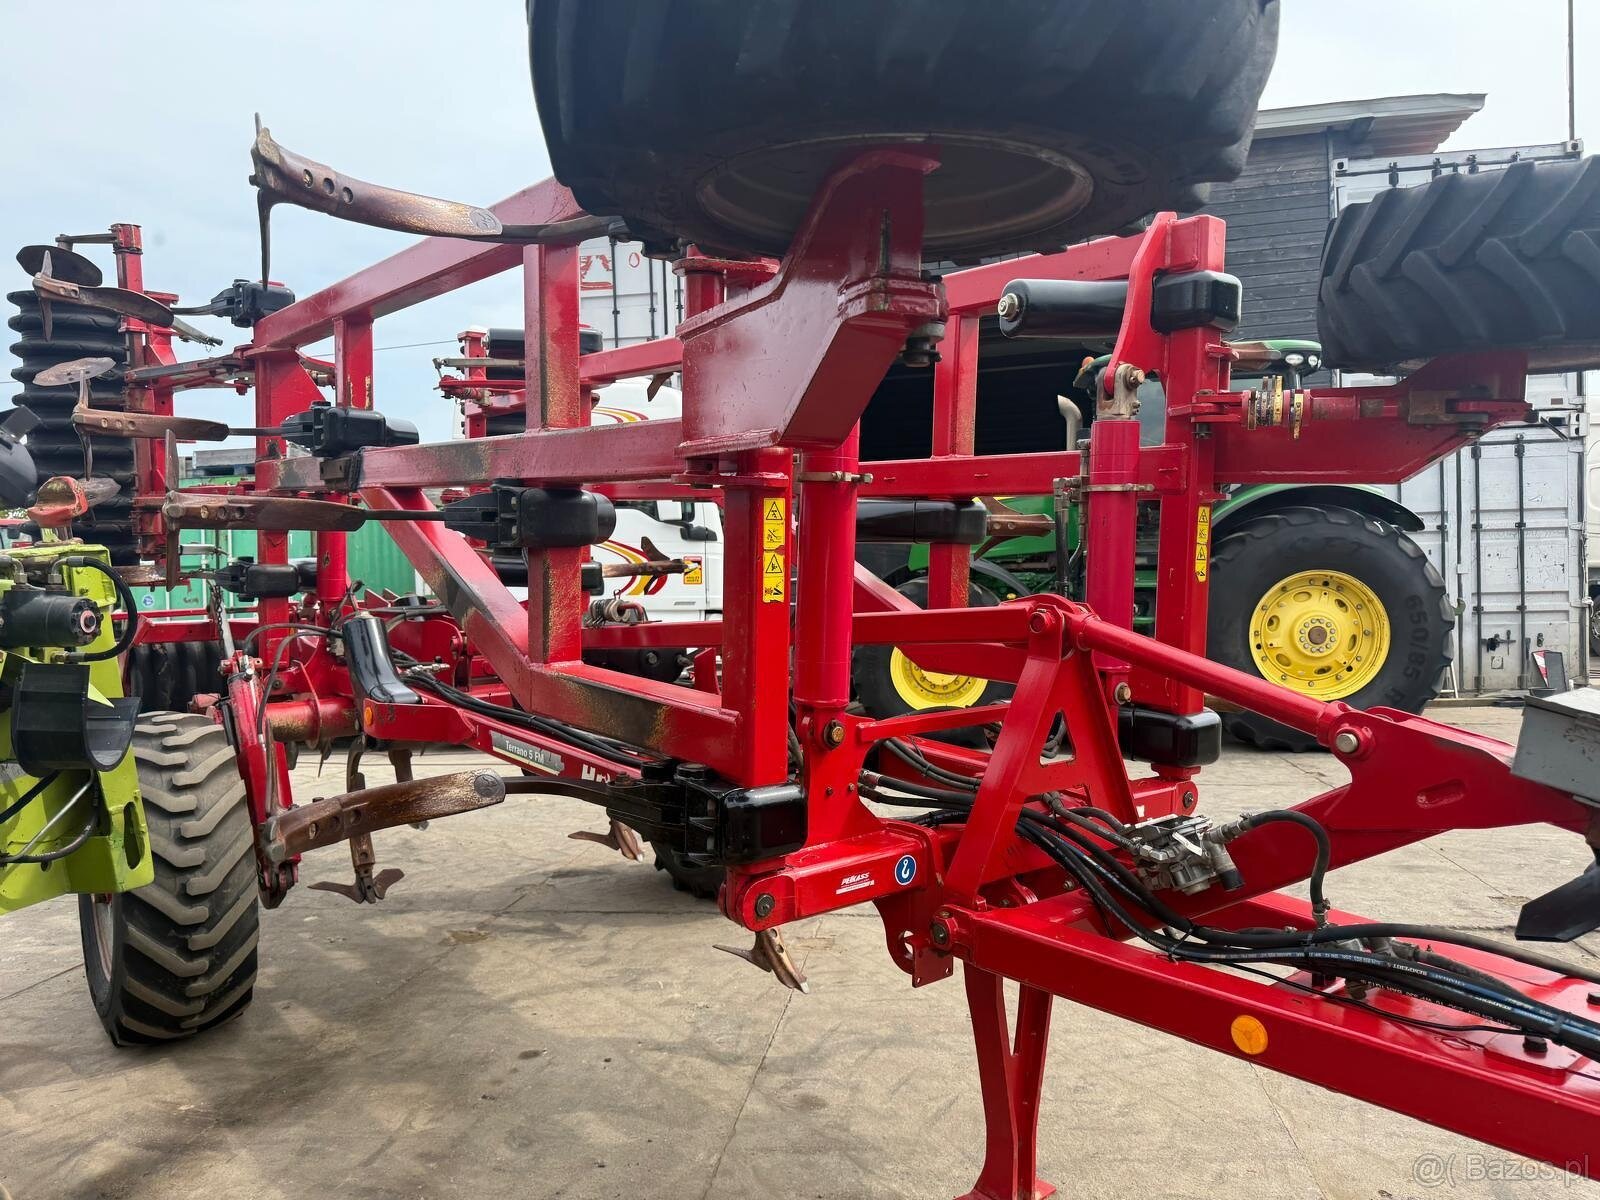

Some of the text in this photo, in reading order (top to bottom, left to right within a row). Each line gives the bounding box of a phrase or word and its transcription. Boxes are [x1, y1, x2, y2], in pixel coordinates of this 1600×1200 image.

[1403, 594, 1430, 680] 650/85
[505, 740, 528, 758] Terrano
[534, 751, 545, 764] FM
